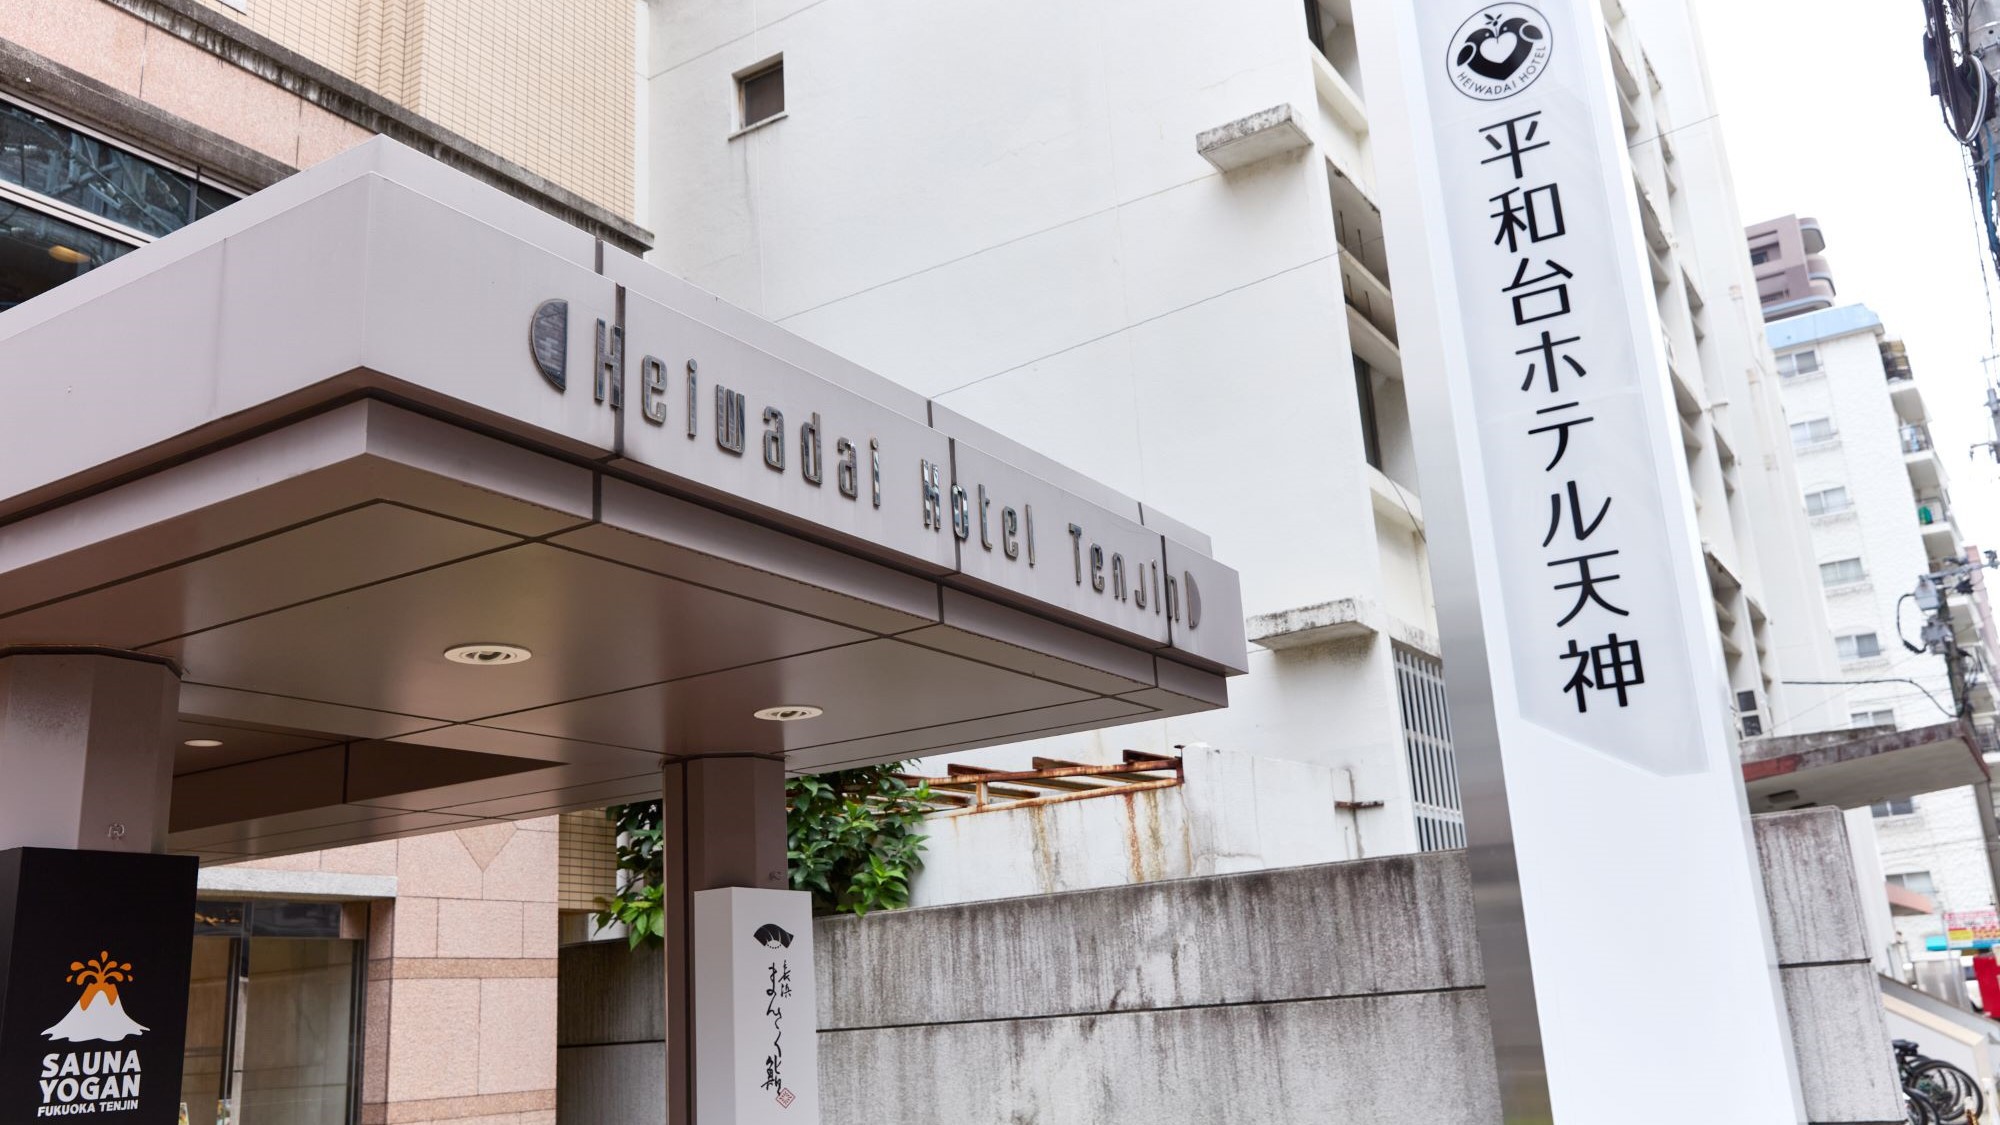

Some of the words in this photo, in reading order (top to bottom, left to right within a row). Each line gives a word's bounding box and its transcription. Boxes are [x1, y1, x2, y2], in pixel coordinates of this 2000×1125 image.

[1457, 71, 1517, 95] HEIWADAI
[1518, 45, 1546, 83] HOTEL
[1479, 110, 1645, 713] 平和台ホテル天神
[595, 317, 881, 507] Heiwadai
[921, 458, 1036, 566] Hotel
[41, 1050, 142, 1078] SAUNA
[37, 1102, 96, 1117] FUKUOKA
[99, 1099, 139, 1112] TENJIN
[39, 1074, 141, 1104] YOGAN
